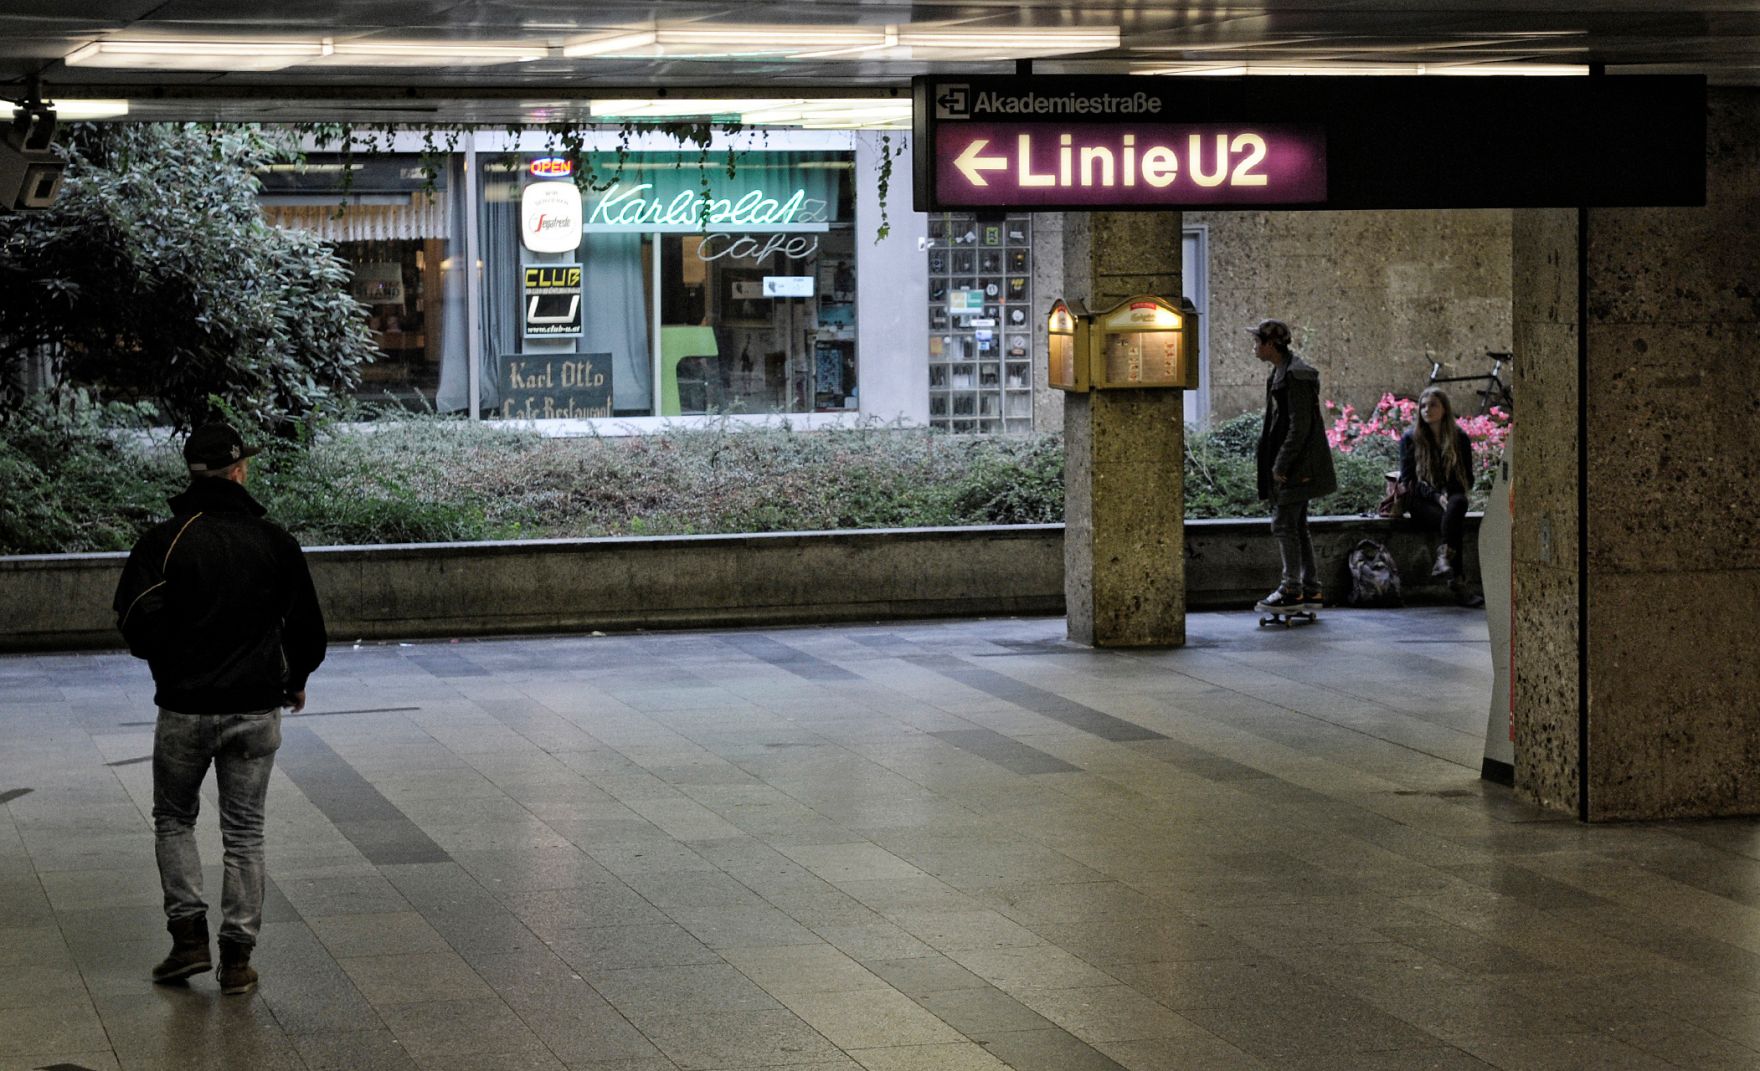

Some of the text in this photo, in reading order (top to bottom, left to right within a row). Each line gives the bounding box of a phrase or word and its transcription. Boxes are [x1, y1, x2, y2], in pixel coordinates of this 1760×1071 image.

[974, 91, 1162, 114] Akademiestraße
[530, 160, 572, 174] OPEN
[1018, 133, 1268, 188] Linie U2
[589, 183, 828, 231] Karlsplatz
[534, 213, 571, 232] Segafredo
[525, 268, 581, 287] CLUB
[527, 294, 580, 324] U
[527, 324, 581, 334] www.club-u.at
[510, 360, 604, 389] Karl Otto
